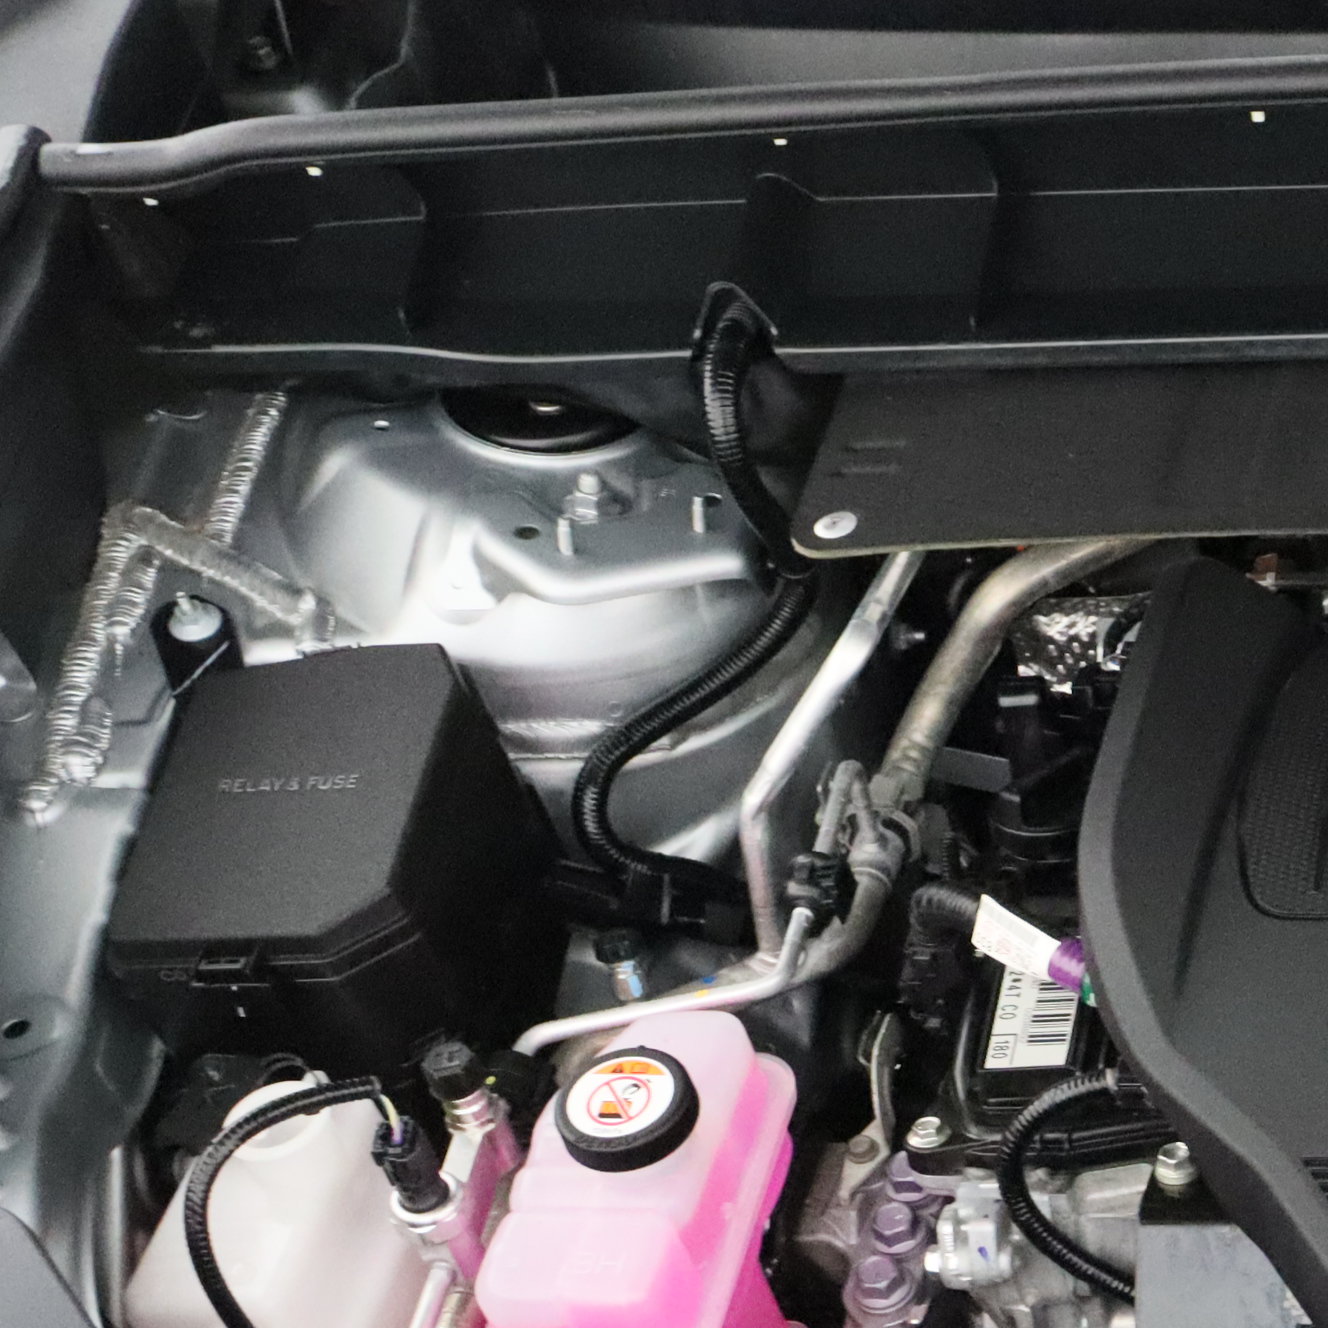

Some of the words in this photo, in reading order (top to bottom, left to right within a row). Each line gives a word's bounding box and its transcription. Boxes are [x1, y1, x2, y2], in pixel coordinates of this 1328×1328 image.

[218, 777, 285, 793] RELAY
[306, 774, 360, 790] FUSE
[990, 1040, 1011, 1059] 180
